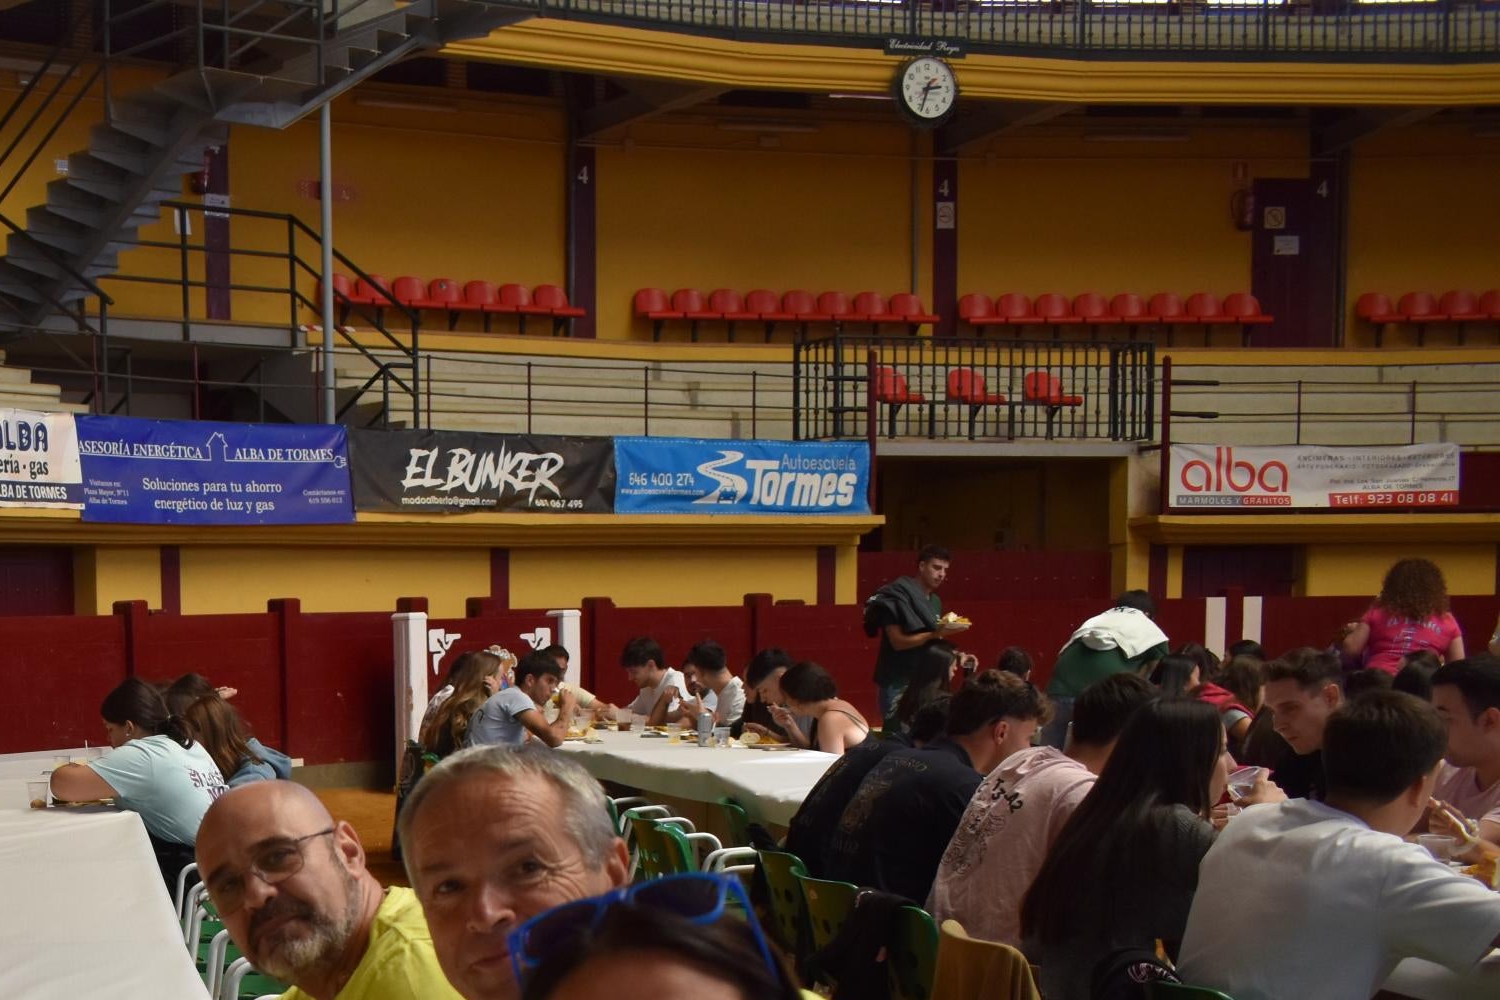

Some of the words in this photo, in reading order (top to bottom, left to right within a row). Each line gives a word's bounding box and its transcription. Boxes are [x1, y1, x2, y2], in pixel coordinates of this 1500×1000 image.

[577, 166, 588, 184] 4
[1316, 180, 1328, 198] 4
[78, 438, 132, 456] ASESORÍA
[133, 441, 203, 459] ENERGÉTICA
[234, 448, 267, 461] ALBA
[268, 448, 284, 461] DE
[285, 448, 334, 461] TORMES
[29, 461, 49, 480] gas
[781, 453, 856, 471] Autoescuela
[1180, 446, 1289, 493] alba
[400, 445, 446, 492] EL
[437, 439, 565, 507] BUNKER
[629, 472, 647, 486] 646
[651, 472, 673, 487] 400
[676, 473, 695, 487] 274
[16, 484, 28, 499] DE
[28, 484, 67, 500] TORMES
[142, 477, 200, 493] Soluciones
[203, 482, 228, 497] para
[230, 481, 243, 493] tu
[245, 480, 282, 494] ahorro
[745, 459, 858, 507] Tormes
[154, 496, 208, 515] energético
[210, 498, 224, 511] de
[227, 498, 243, 511] luz
[246, 502, 252, 515] y
[256, 501, 275, 515] gas
[567, 499, 583, 509] 495
[1179, 495, 1234, 506] MARMOLES
[1235, 496, 1242, 505] Y
[1243, 495, 1291, 506] GRANITOS
[1334, 494, 1362, 505] Telf:
[1367, 494, 1393, 505] 923
[1397, 493, 1414, 504] 08
[1418, 493, 1436, 504] 08
[1440, 492, 1453, 503] 41
